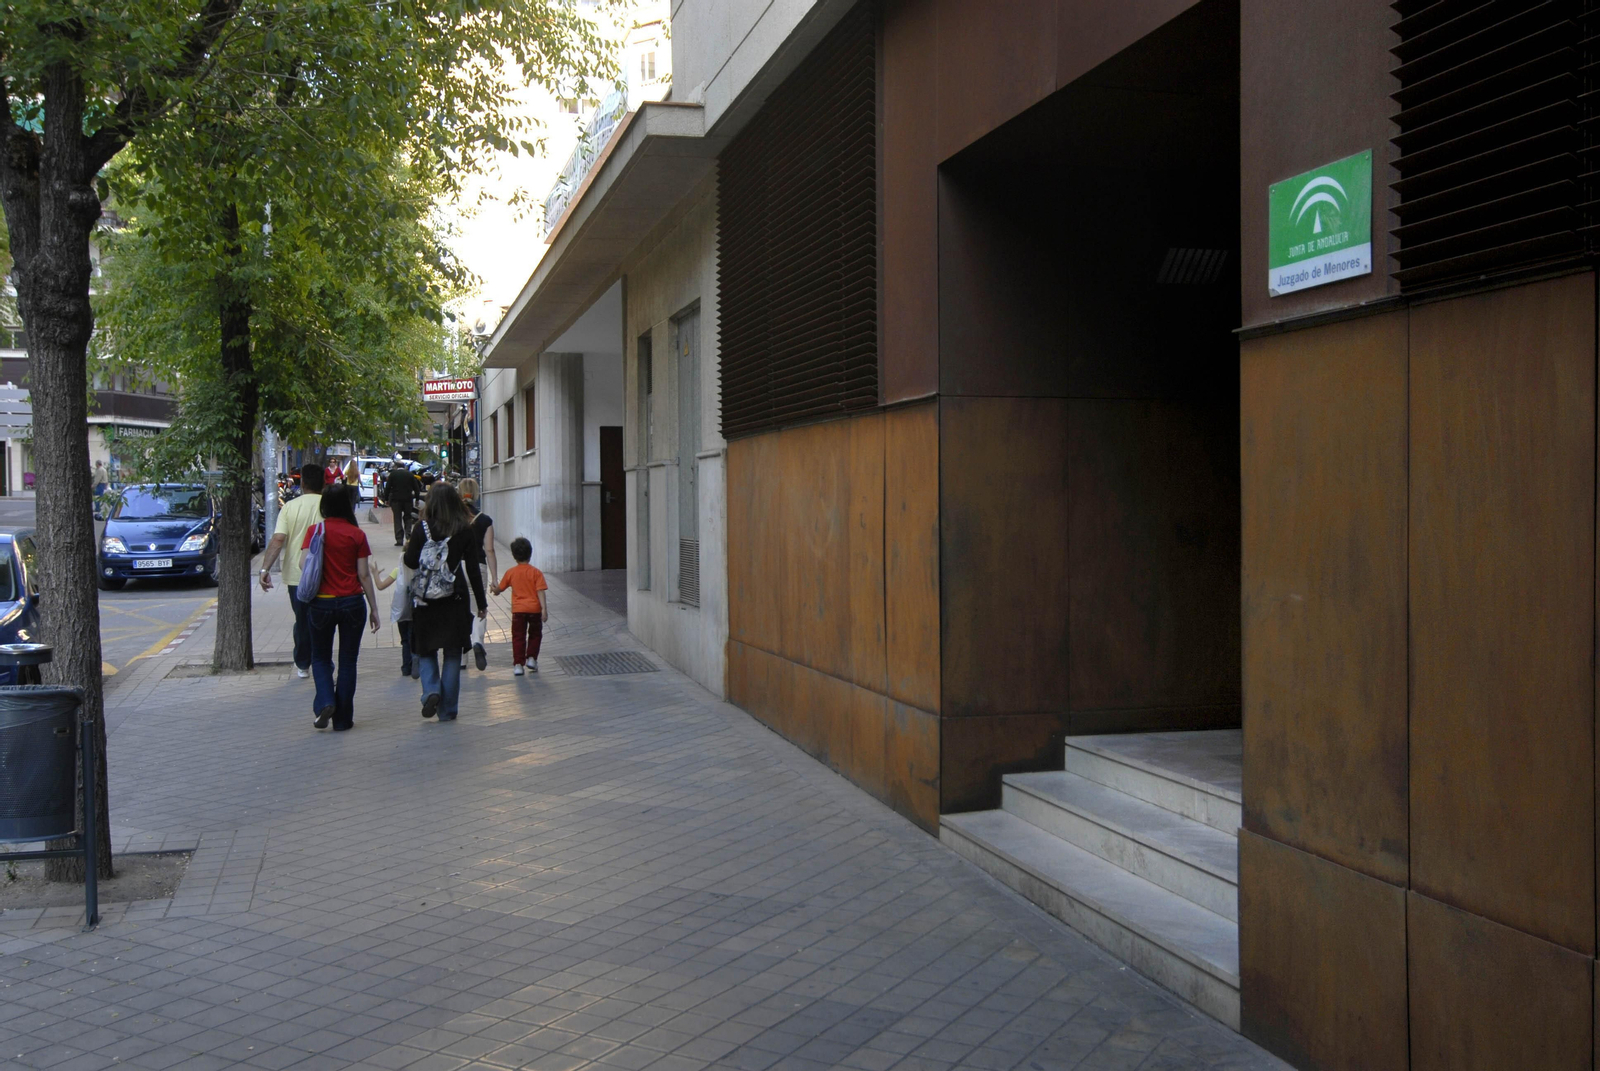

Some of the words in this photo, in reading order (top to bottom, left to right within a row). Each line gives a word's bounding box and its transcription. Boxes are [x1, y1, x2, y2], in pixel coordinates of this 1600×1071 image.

[1288, 244, 1306, 258] JUNTA
[1308, 240, 1315, 253] DE
[1277, 269, 1309, 287] Juzgado
[1311, 266, 1322, 279] de
[1323, 257, 1361, 276] Menores
[119, 427, 155, 438] FARMACIA
